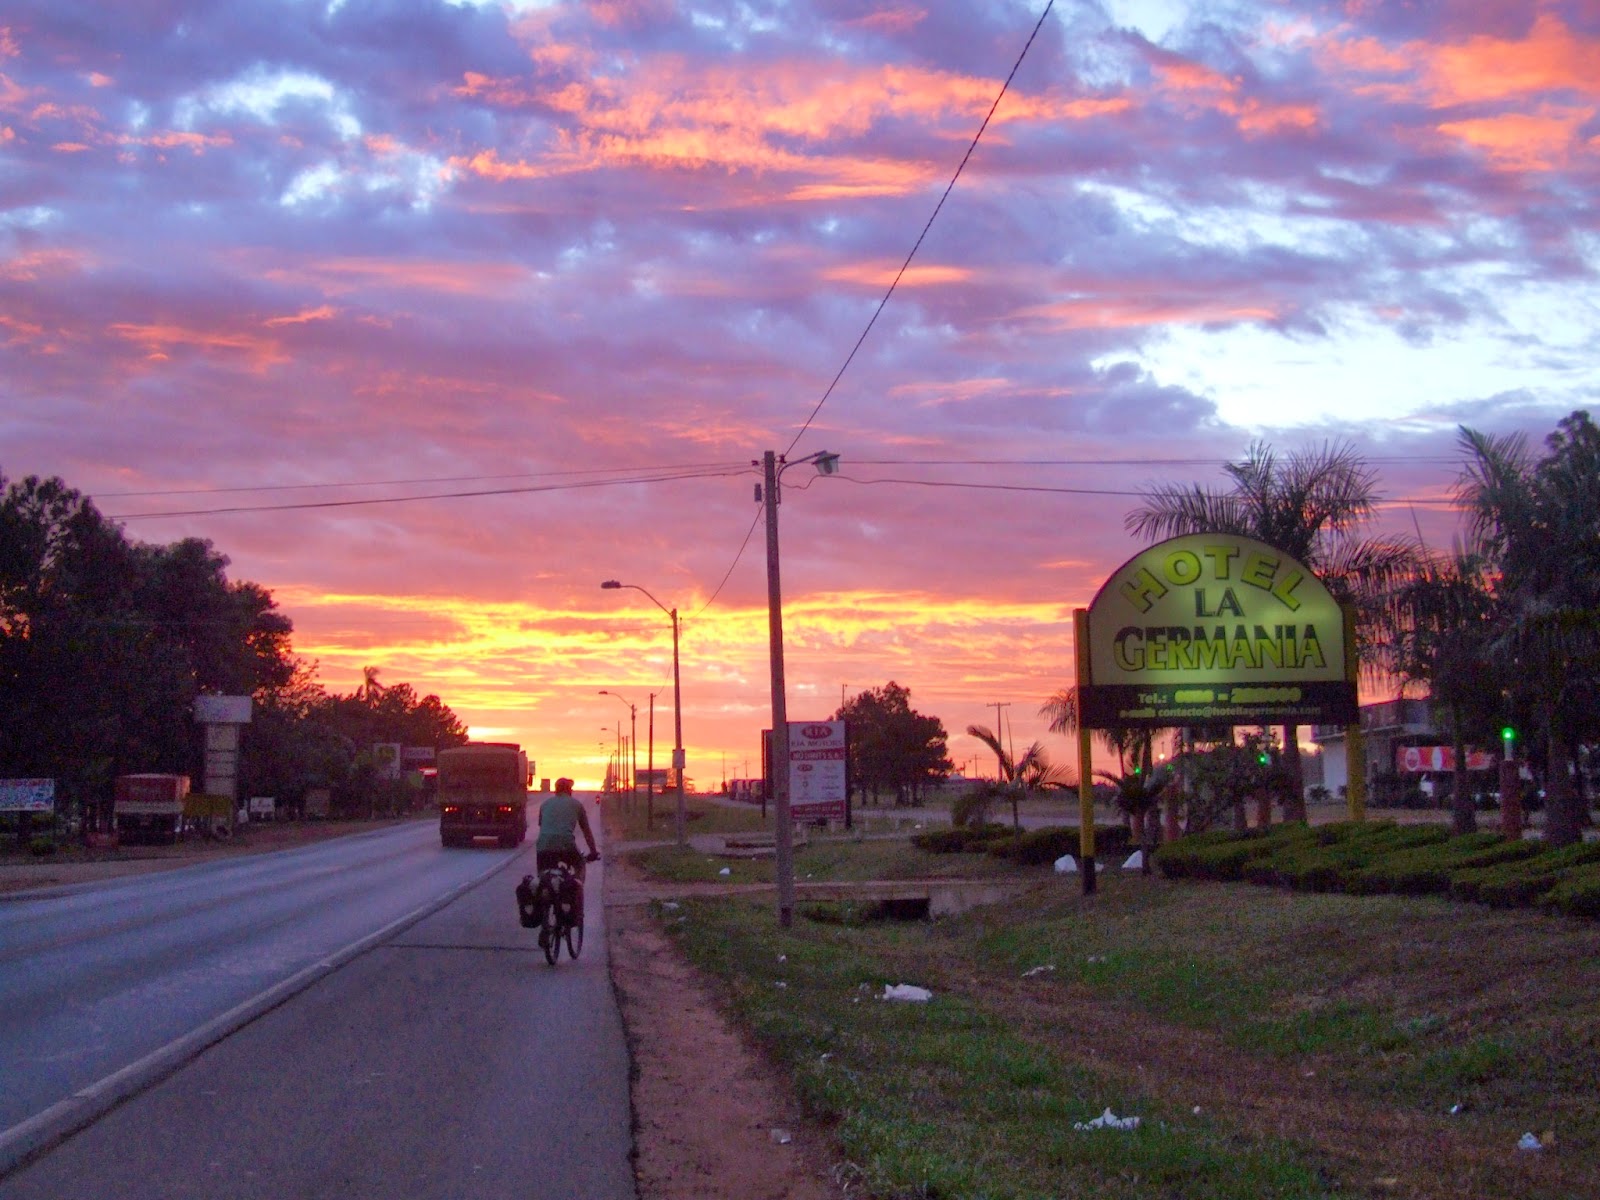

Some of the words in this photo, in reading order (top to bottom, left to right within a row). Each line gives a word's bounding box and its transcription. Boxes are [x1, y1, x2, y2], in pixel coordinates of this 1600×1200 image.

[1119, 545, 1304, 614] HOTEL
[1194, 587, 1246, 618] LA
[1113, 624, 1328, 672] GERMANIA
